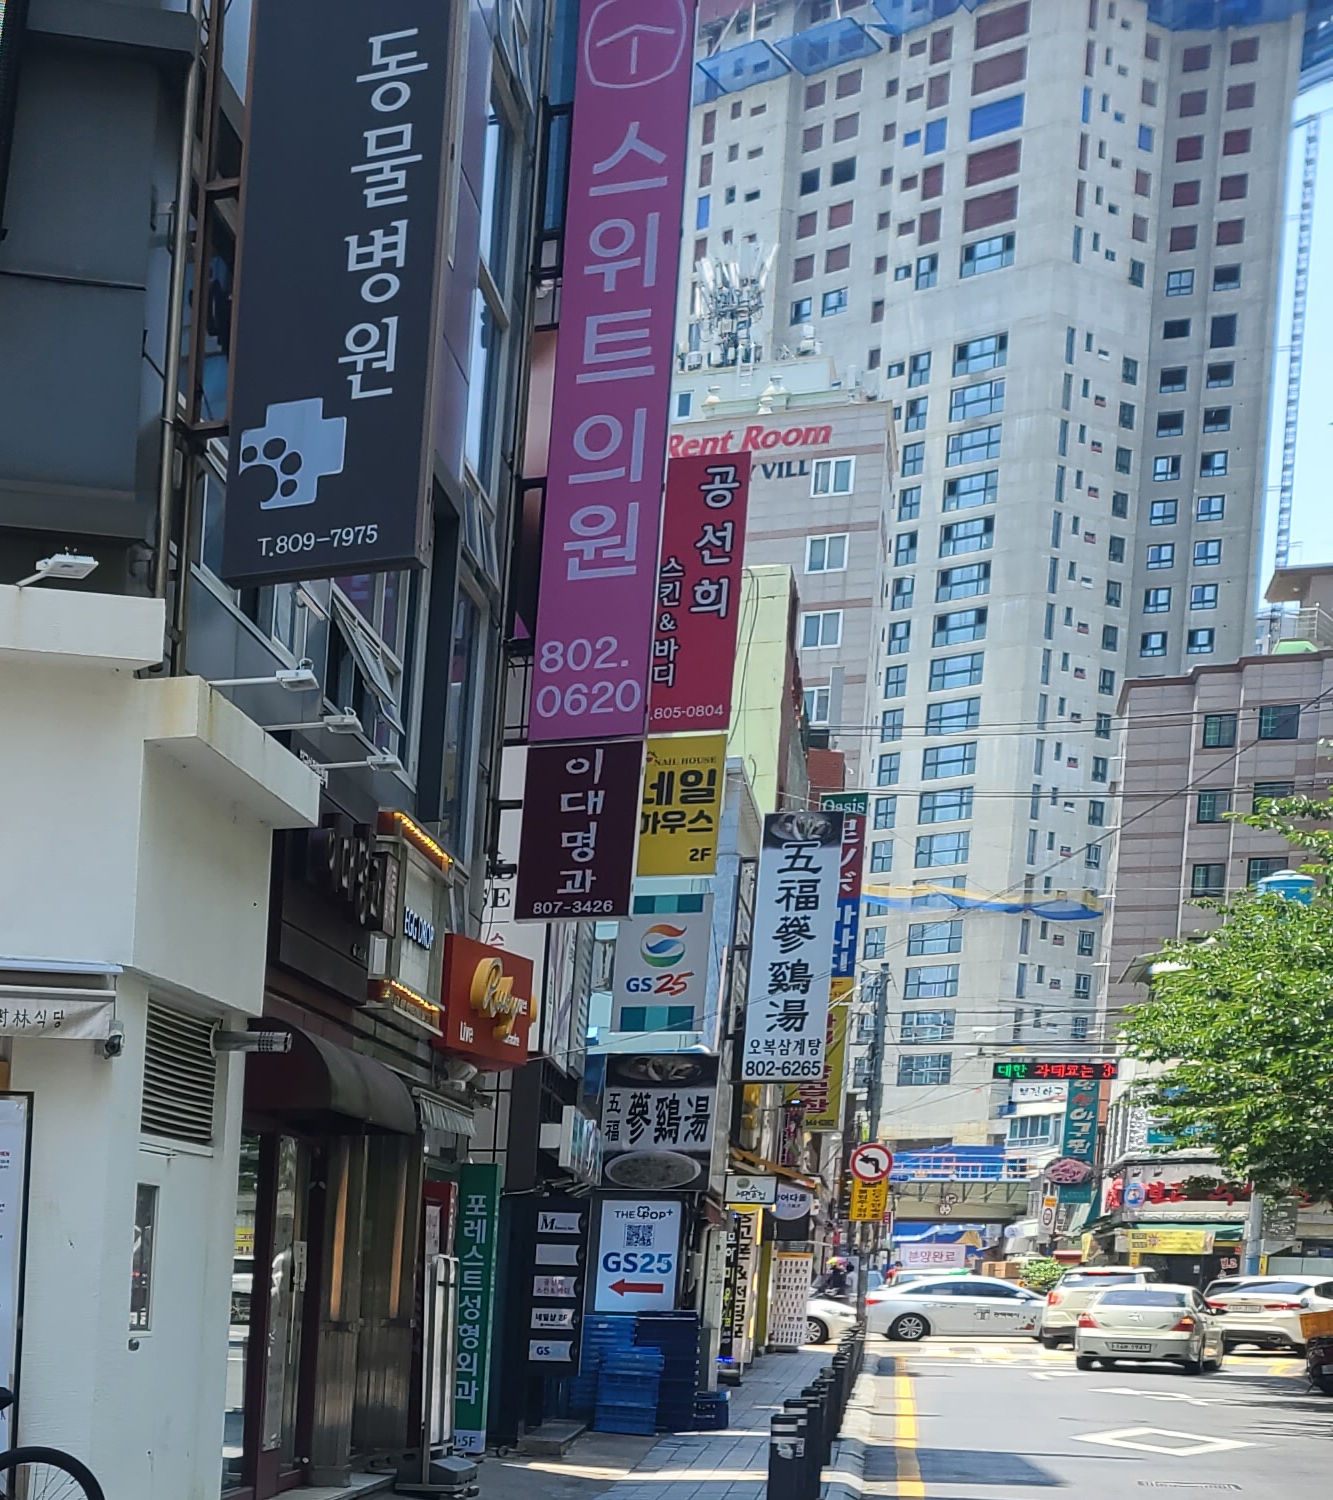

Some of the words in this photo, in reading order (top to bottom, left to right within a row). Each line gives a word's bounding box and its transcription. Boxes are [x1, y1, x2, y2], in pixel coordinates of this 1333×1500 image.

[339, 28, 429, 400] 동물병원
[563, 122, 667, 582] 스위트의원
[669, 430, 735, 457] Rent
[741, 424, 833, 450] Room
[761, 459, 810, 480] VILL
[258, 524, 379, 558] T.809-7975
[690, 465, 740, 618] 공선희
[536, 680, 641, 718] 0620
[680, 755, 718, 766] HOUSE
[823, 797, 865, 813] Oasis
[556, 748, 606, 894] 이대명과
[689, 847, 713, 862] 2F
[533, 900, 614, 915] 807-3426
[625, 973, 695, 997] GS25
[459, 1021, 474, 1044] Live
[748, 1037, 823, 1056] 오복삼계탕
[744, 1060, 822, 1078] 802-6265
[605, 1092, 622, 1142] 五福
[614, 1209, 636, 1220] THE
[602, 1251, 673, 1275] GS25
[455, 1194, 487, 1405] 포레스트성형외과
[536, 1346, 551, 1356] GS
